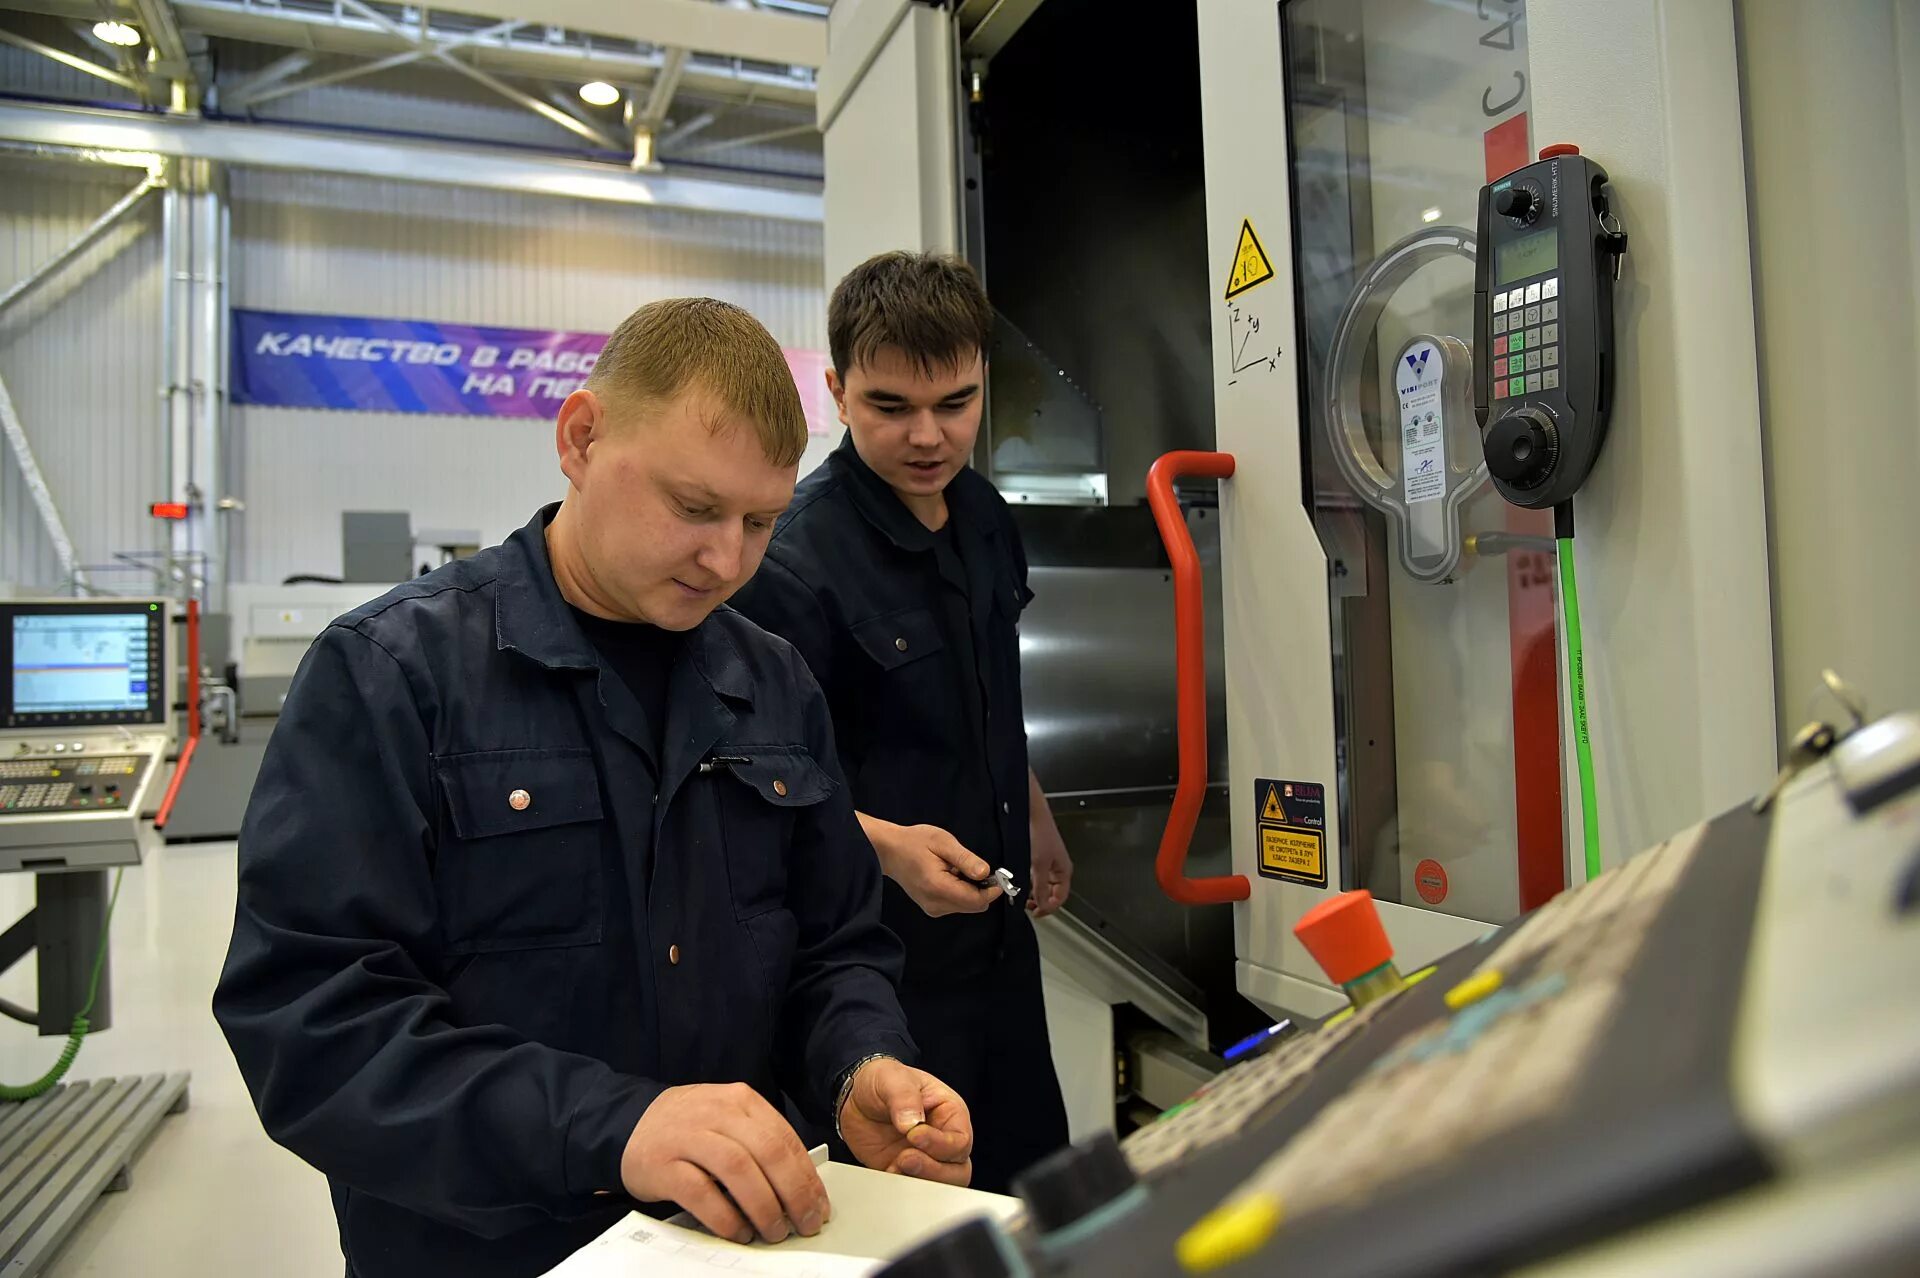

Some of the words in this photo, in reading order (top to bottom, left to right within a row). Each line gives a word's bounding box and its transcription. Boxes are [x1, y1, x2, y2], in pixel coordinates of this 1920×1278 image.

[1482, 70, 1526, 117] C
[256, 332, 462, 366] КАЧЕСТВО
[469, 346, 500, 368] В
[462, 373, 514, 397] НА
[527, 376, 587, 399] ПЕ
[1401, 378, 1438, 395] VISIPORT
